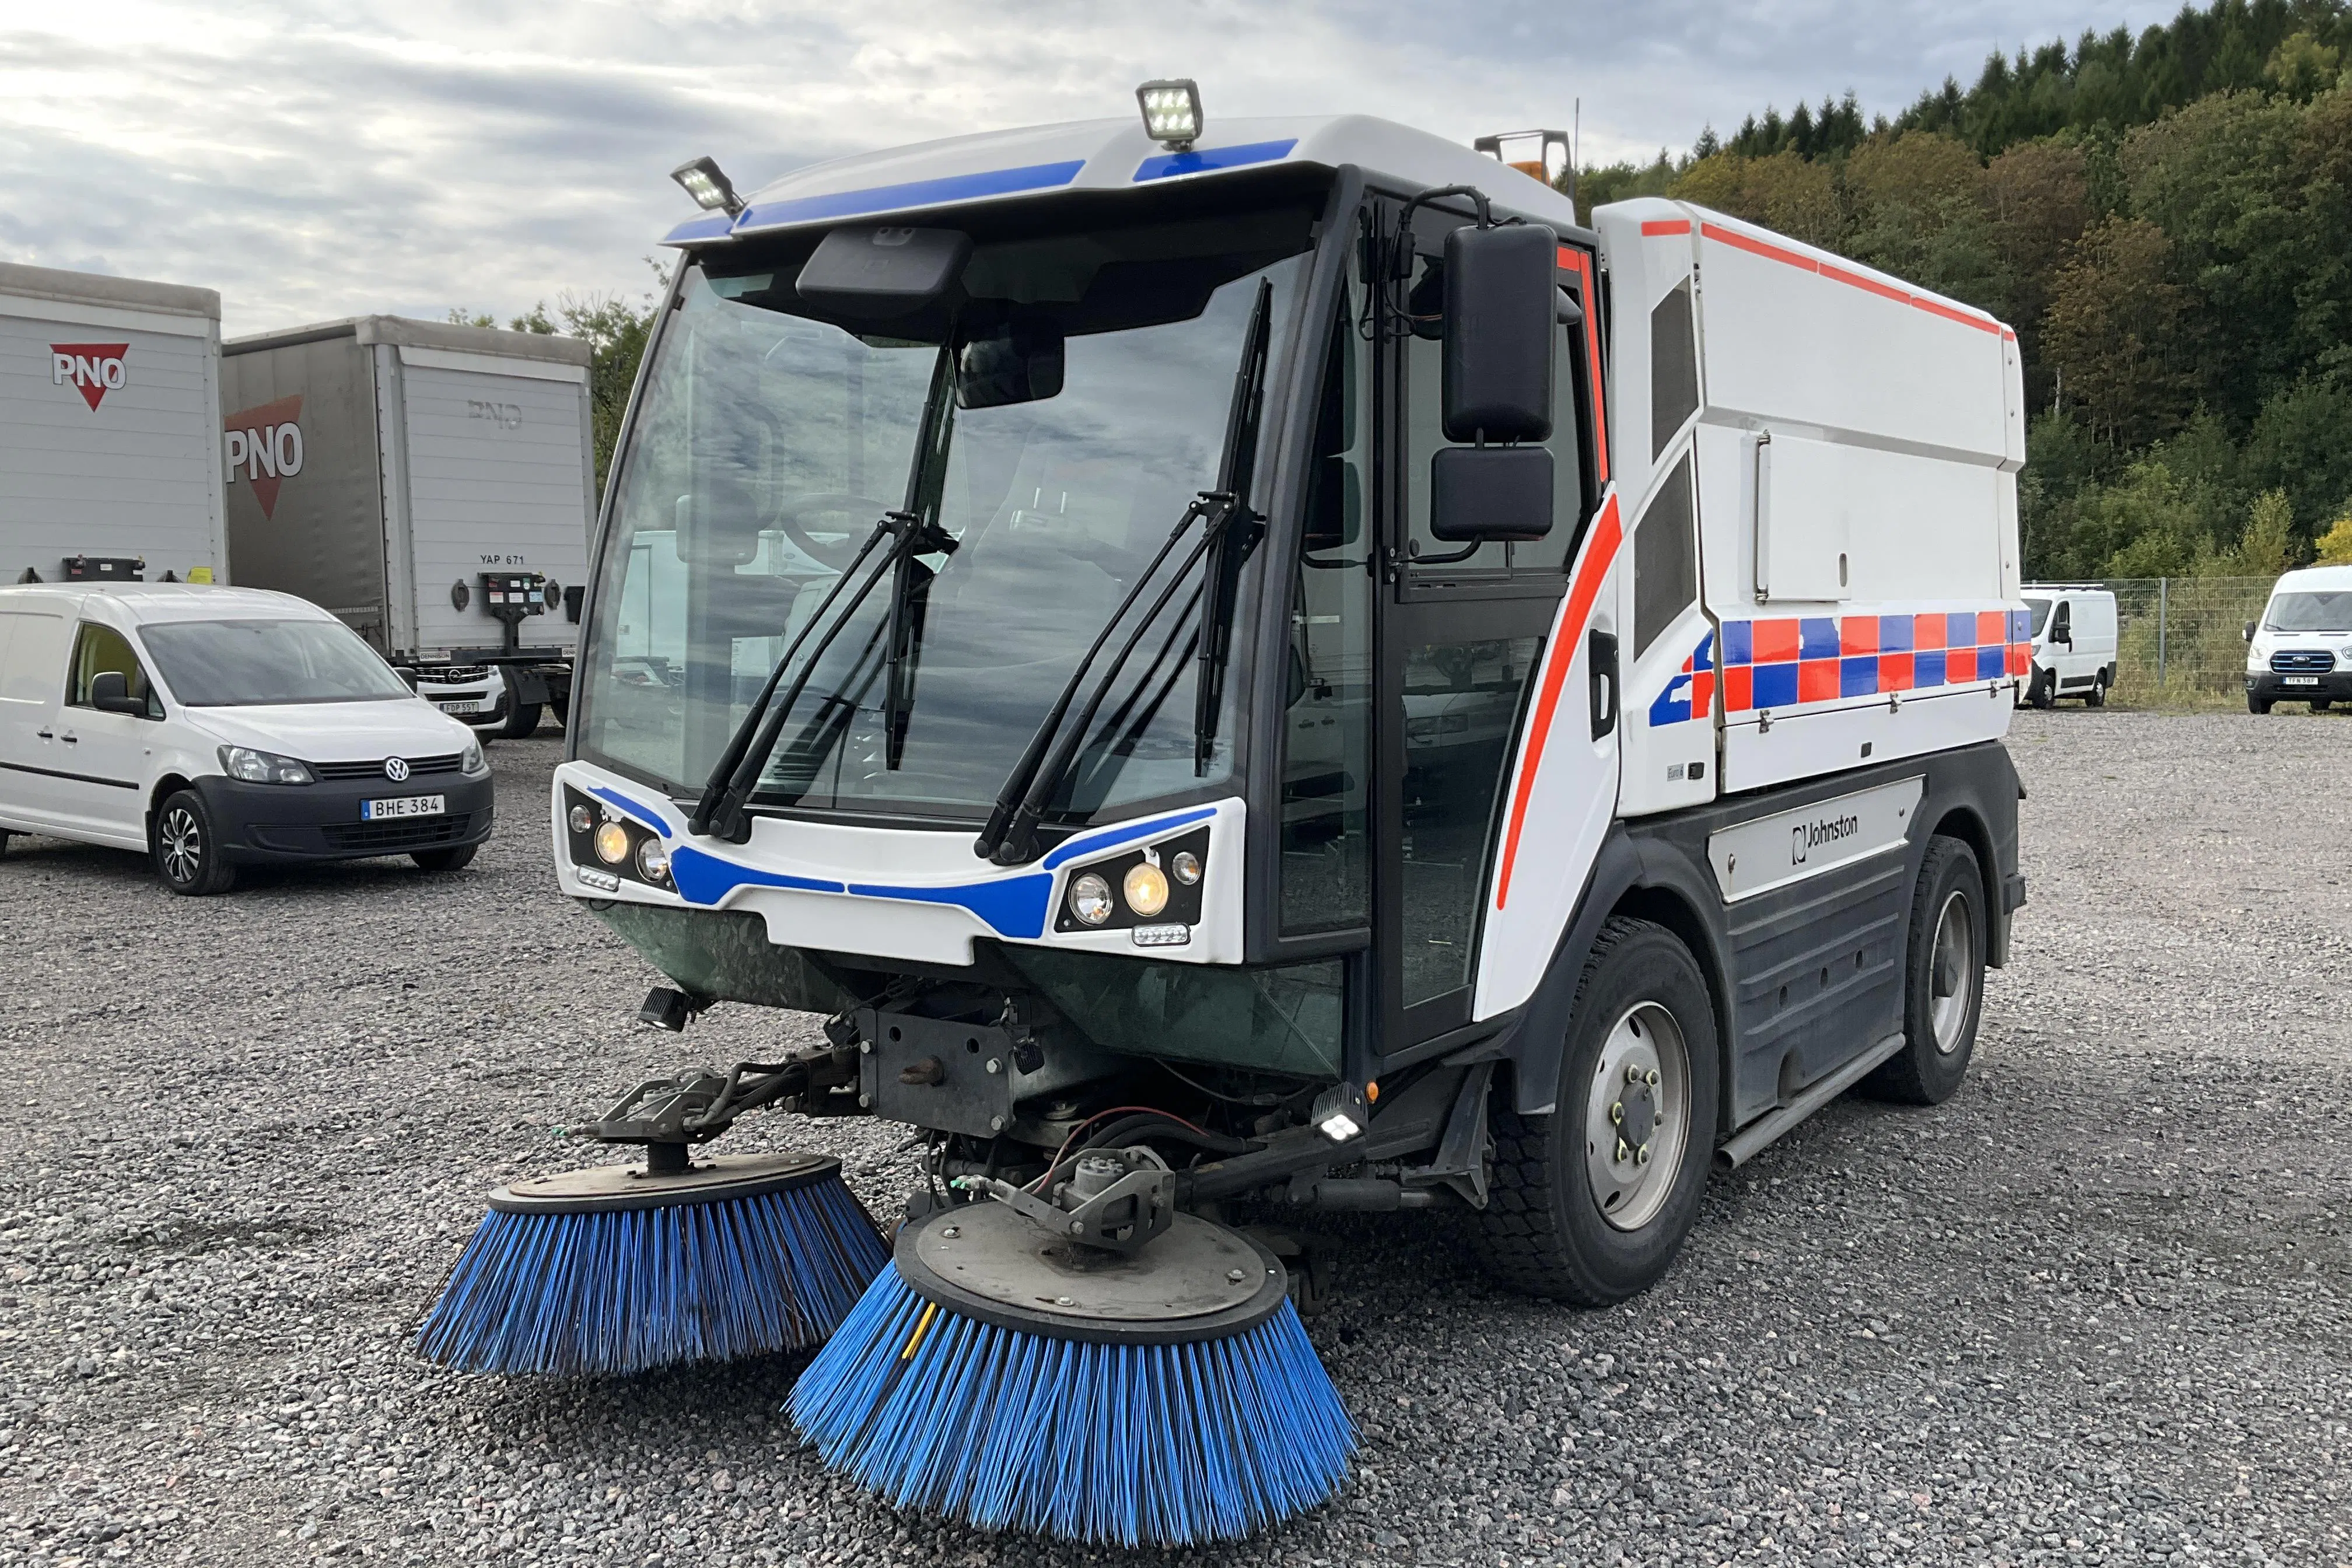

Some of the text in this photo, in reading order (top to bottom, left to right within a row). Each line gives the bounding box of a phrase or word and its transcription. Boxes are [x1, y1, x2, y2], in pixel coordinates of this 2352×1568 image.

[52, 352, 127, 390] PNO
[225, 421, 304, 484] PNO
[480, 555, 524, 565] YAP 671
[1668, 768, 1679, 778] Euro
[376, 797, 439, 817] BHE 384
[1808, 814, 1857, 848] Johnston
